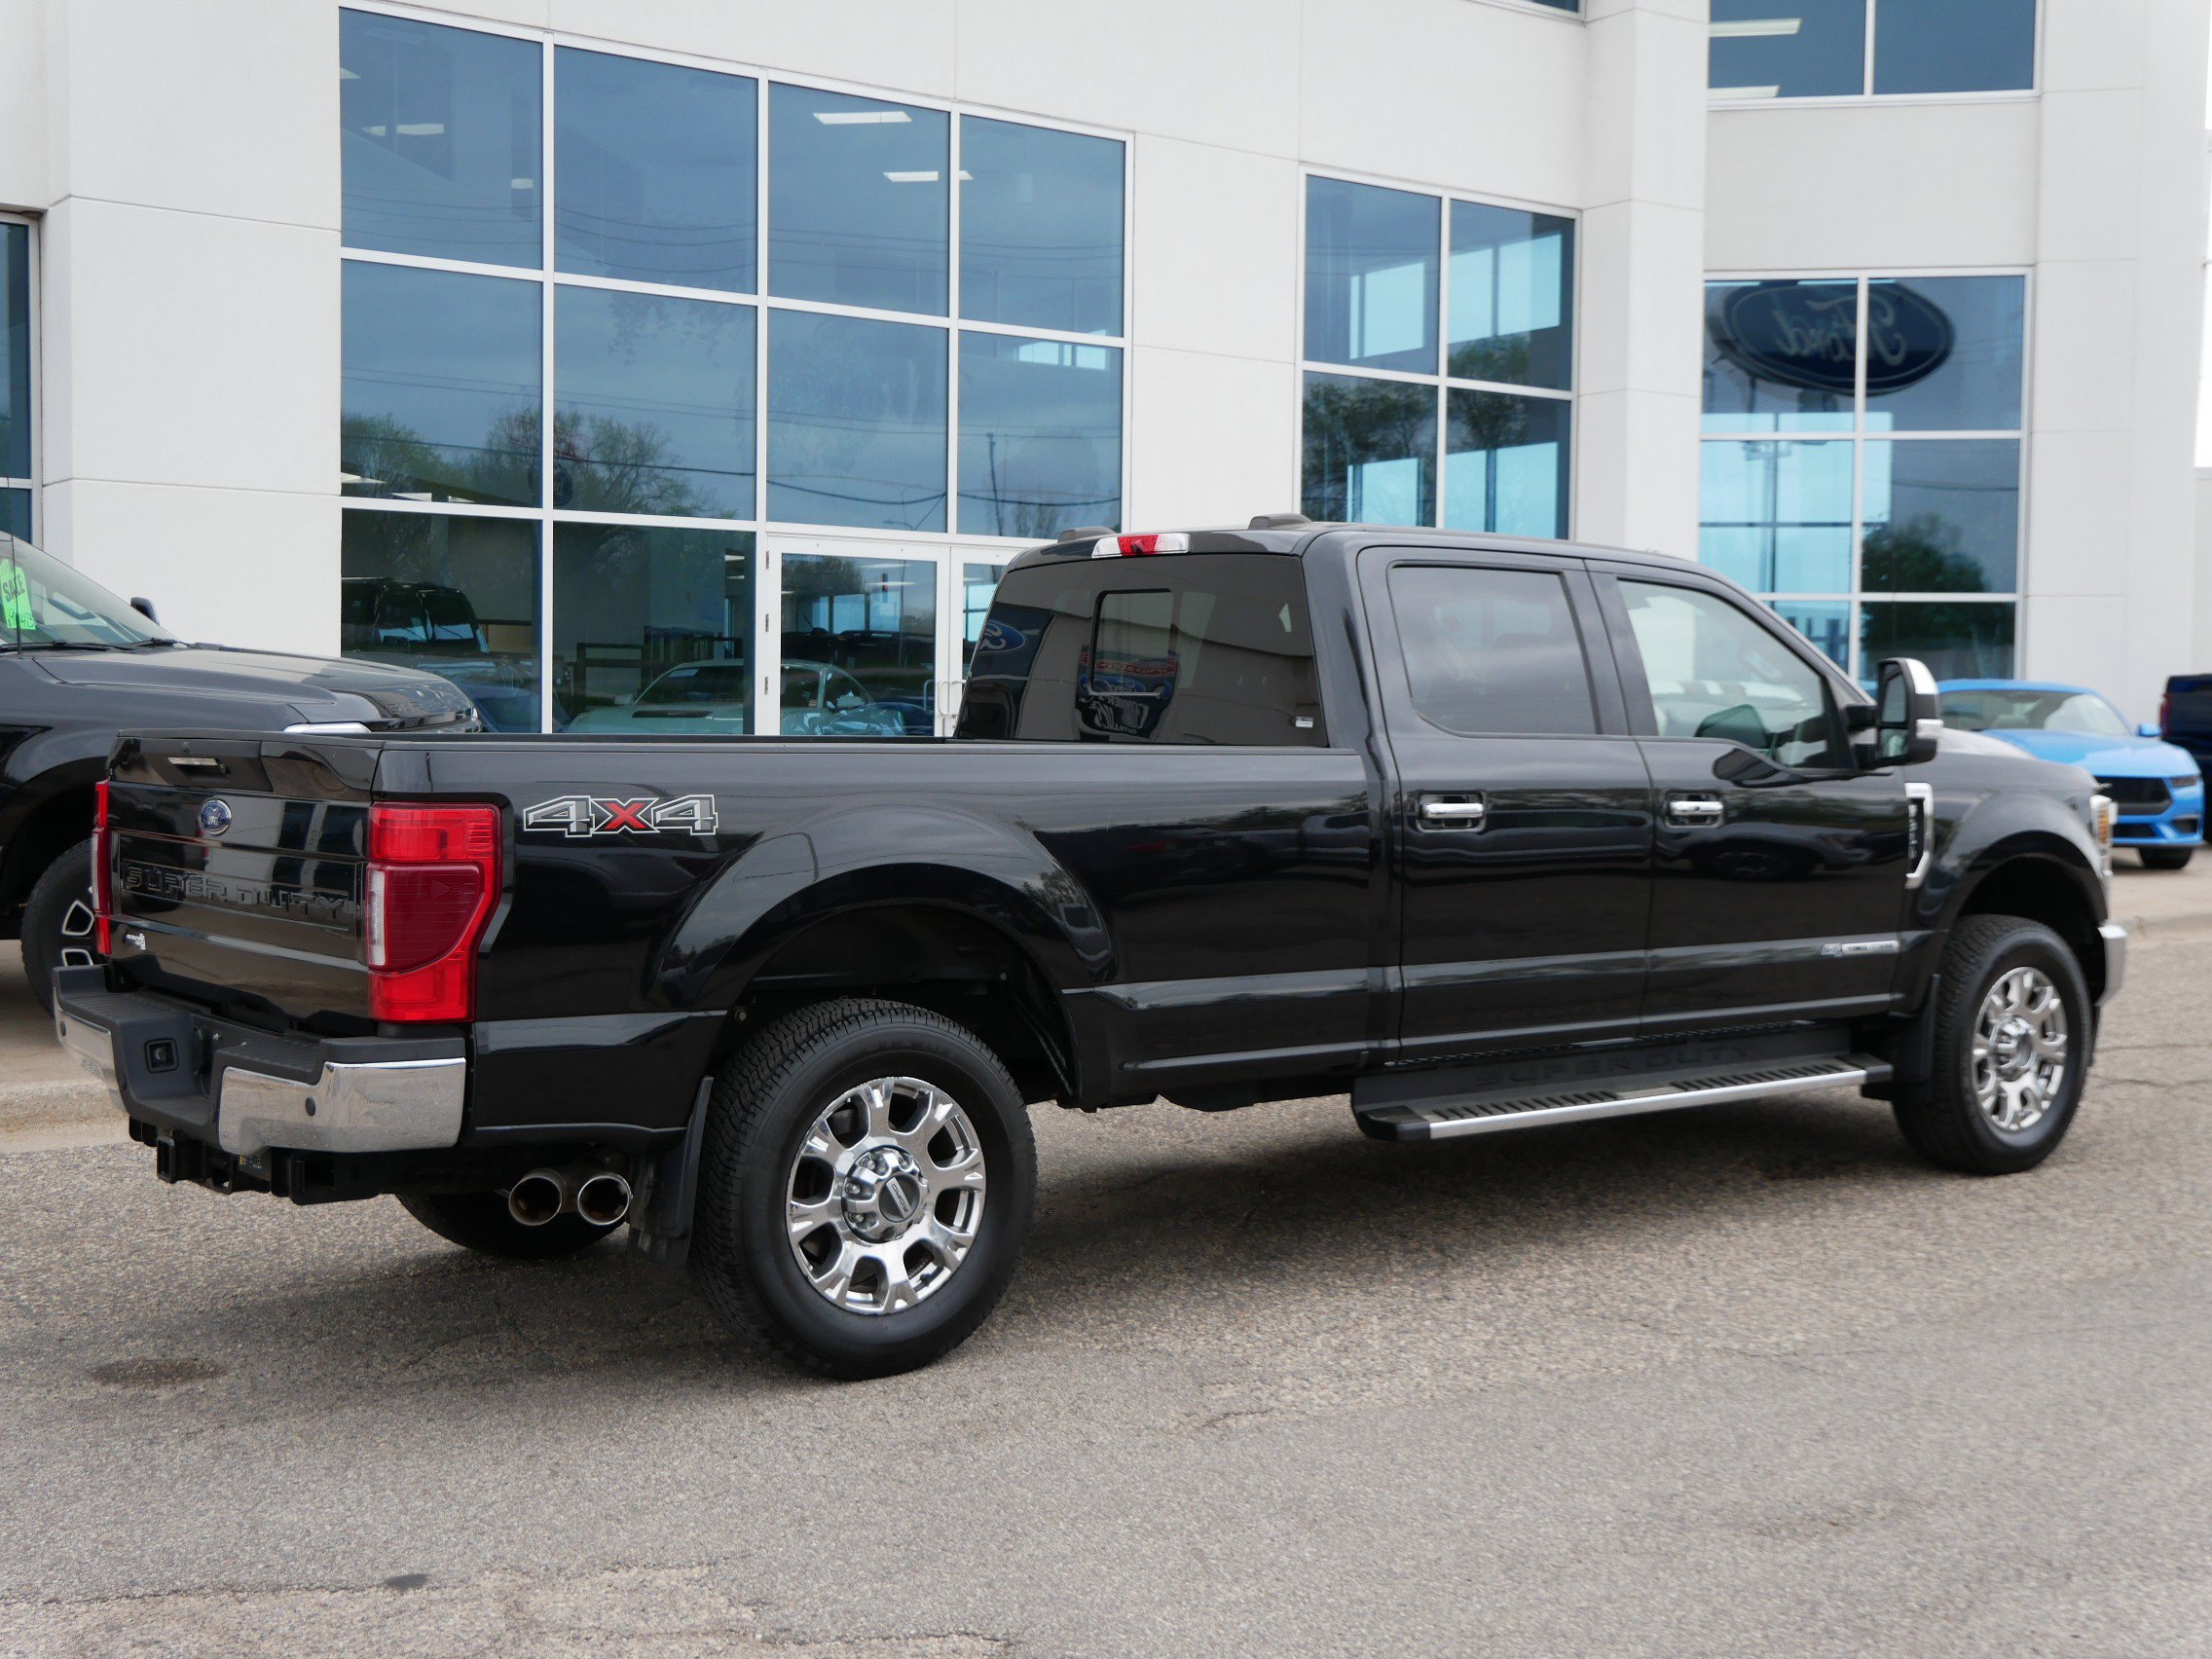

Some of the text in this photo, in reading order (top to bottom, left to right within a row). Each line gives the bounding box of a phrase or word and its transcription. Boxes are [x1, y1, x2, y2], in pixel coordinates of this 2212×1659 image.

[523, 794, 719, 837] 4X4
[126, 866, 347, 919] SUPER DUTY
